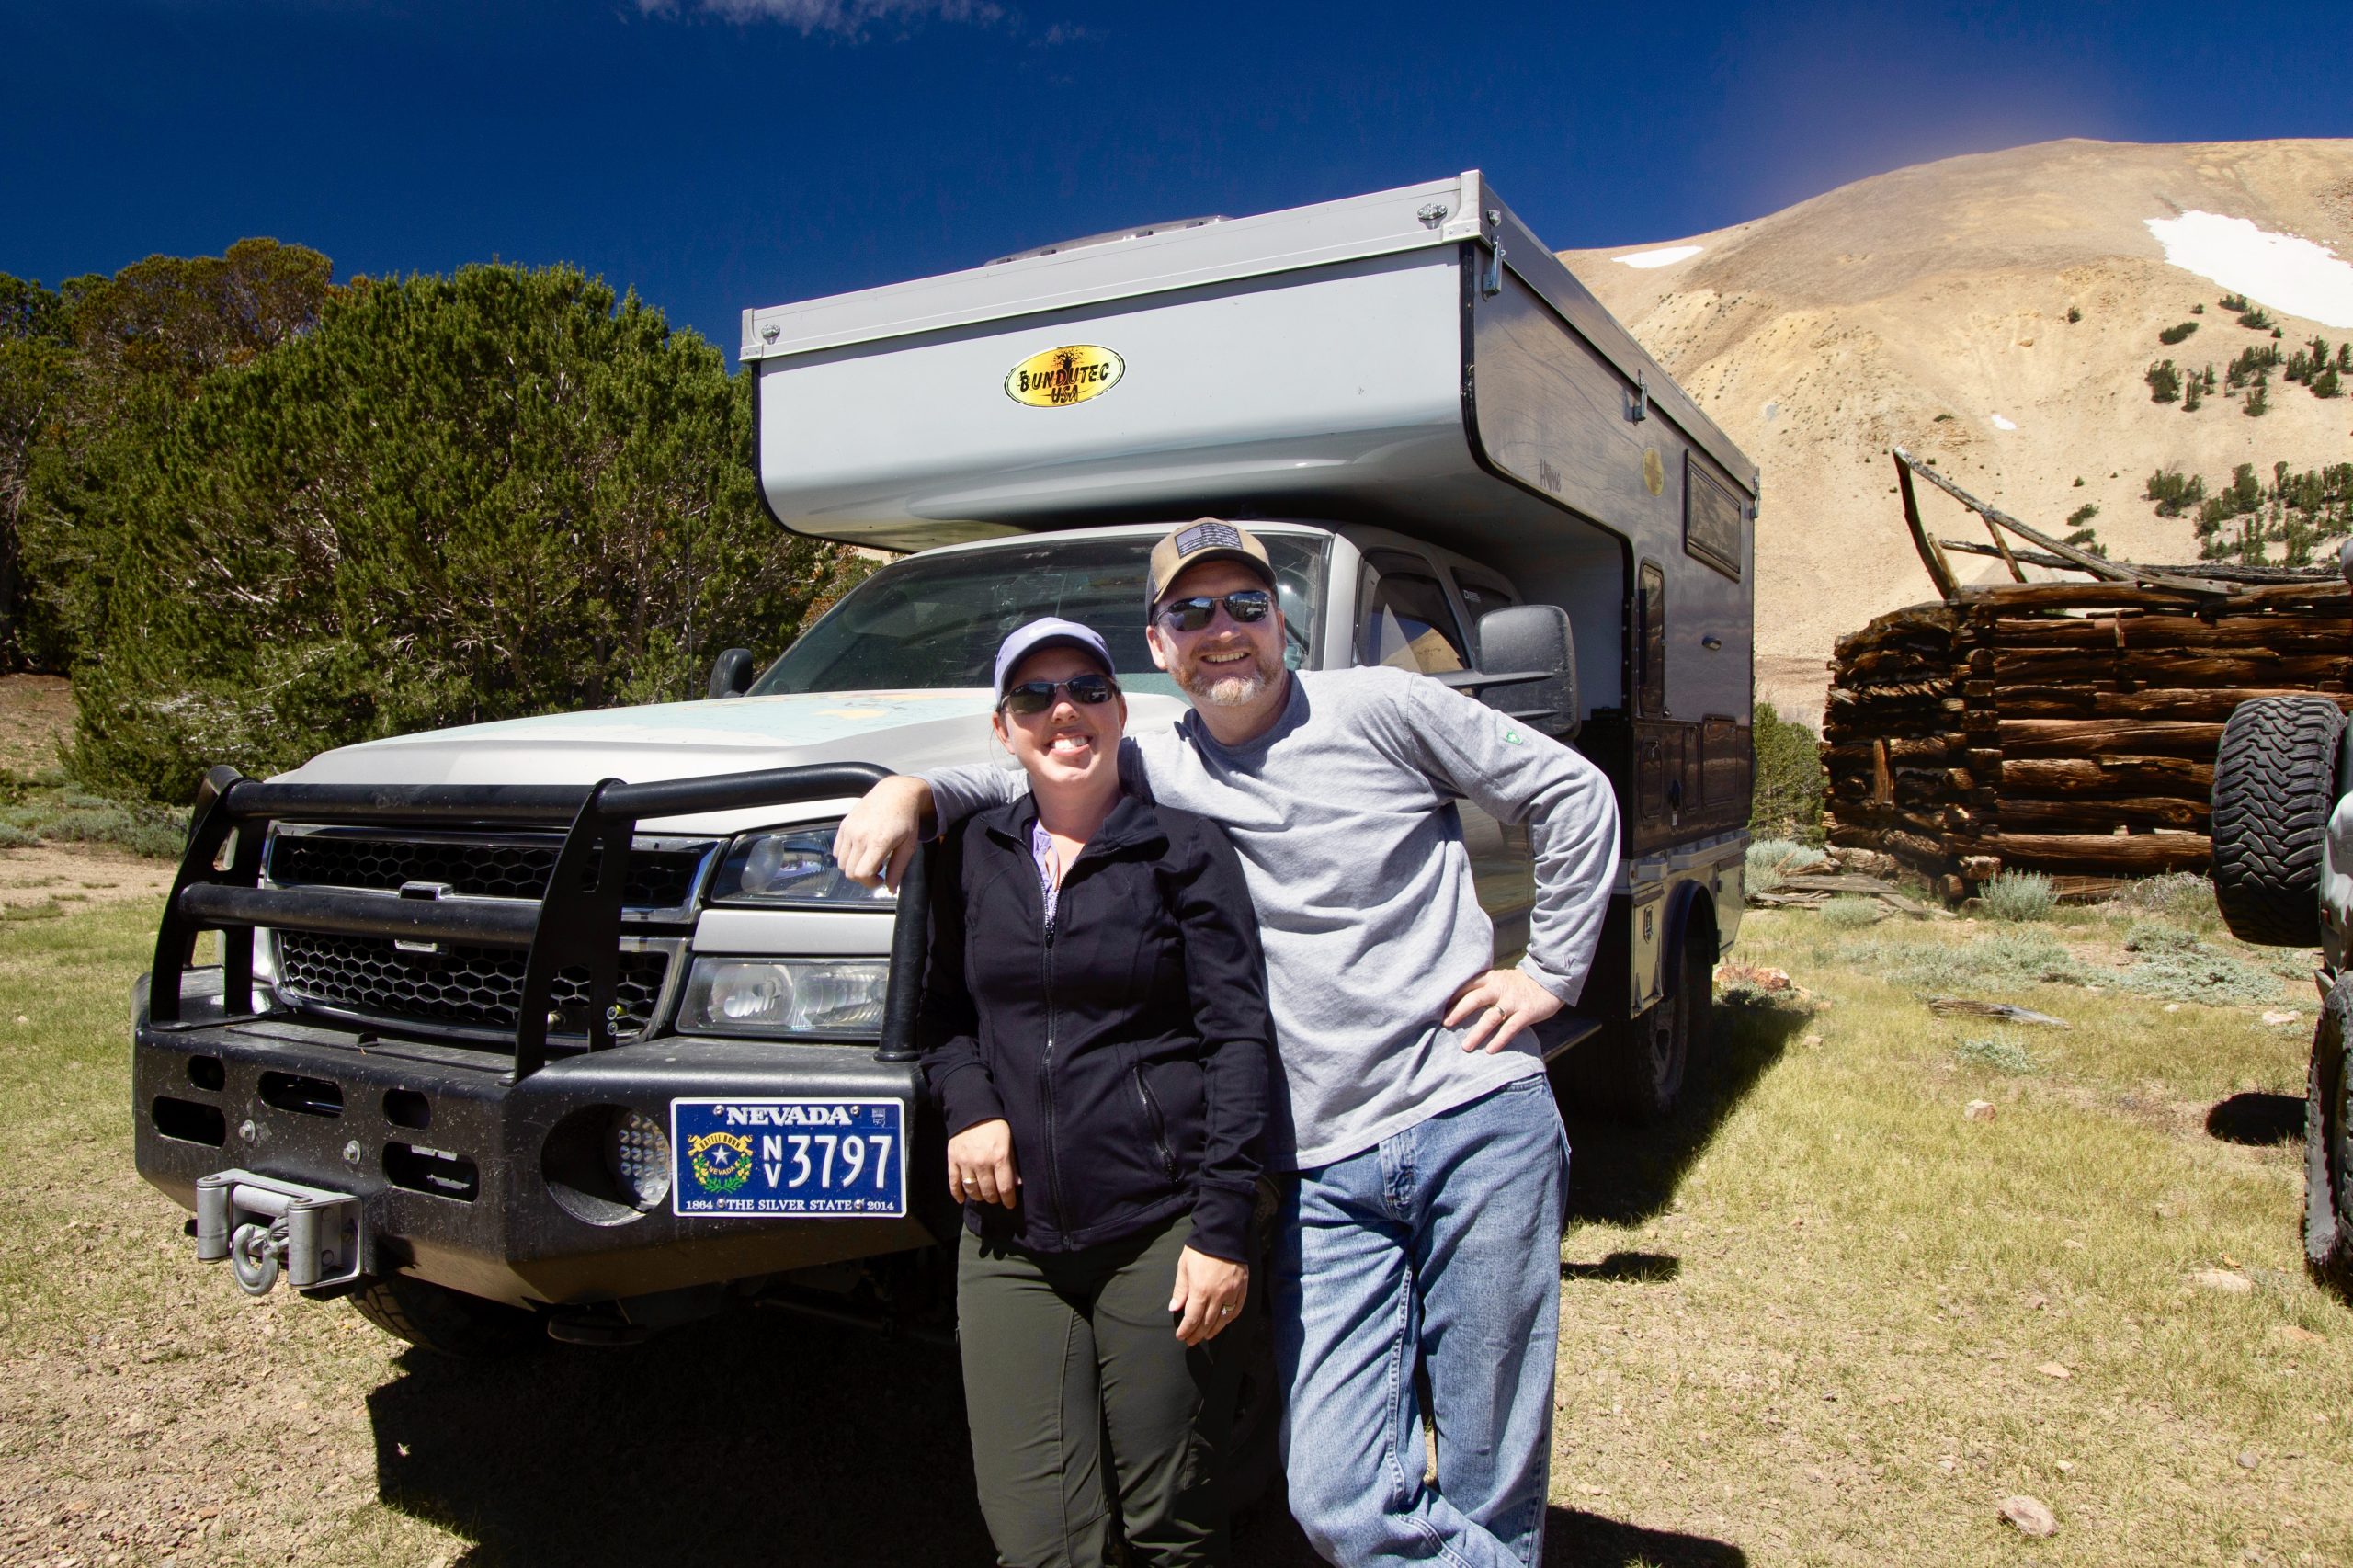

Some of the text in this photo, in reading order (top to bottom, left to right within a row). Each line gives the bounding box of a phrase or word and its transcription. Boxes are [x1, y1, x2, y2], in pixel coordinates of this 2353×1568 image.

[1018, 362, 1110, 392] BUNDUTEC
[1051, 385, 1079, 403] USA
[726, 1106, 852, 1126] NEVADA
[708, 1165, 736, 1176] NEVADA
[686, 1199, 894, 1210] 1864 THE SILVER STATE 2014
